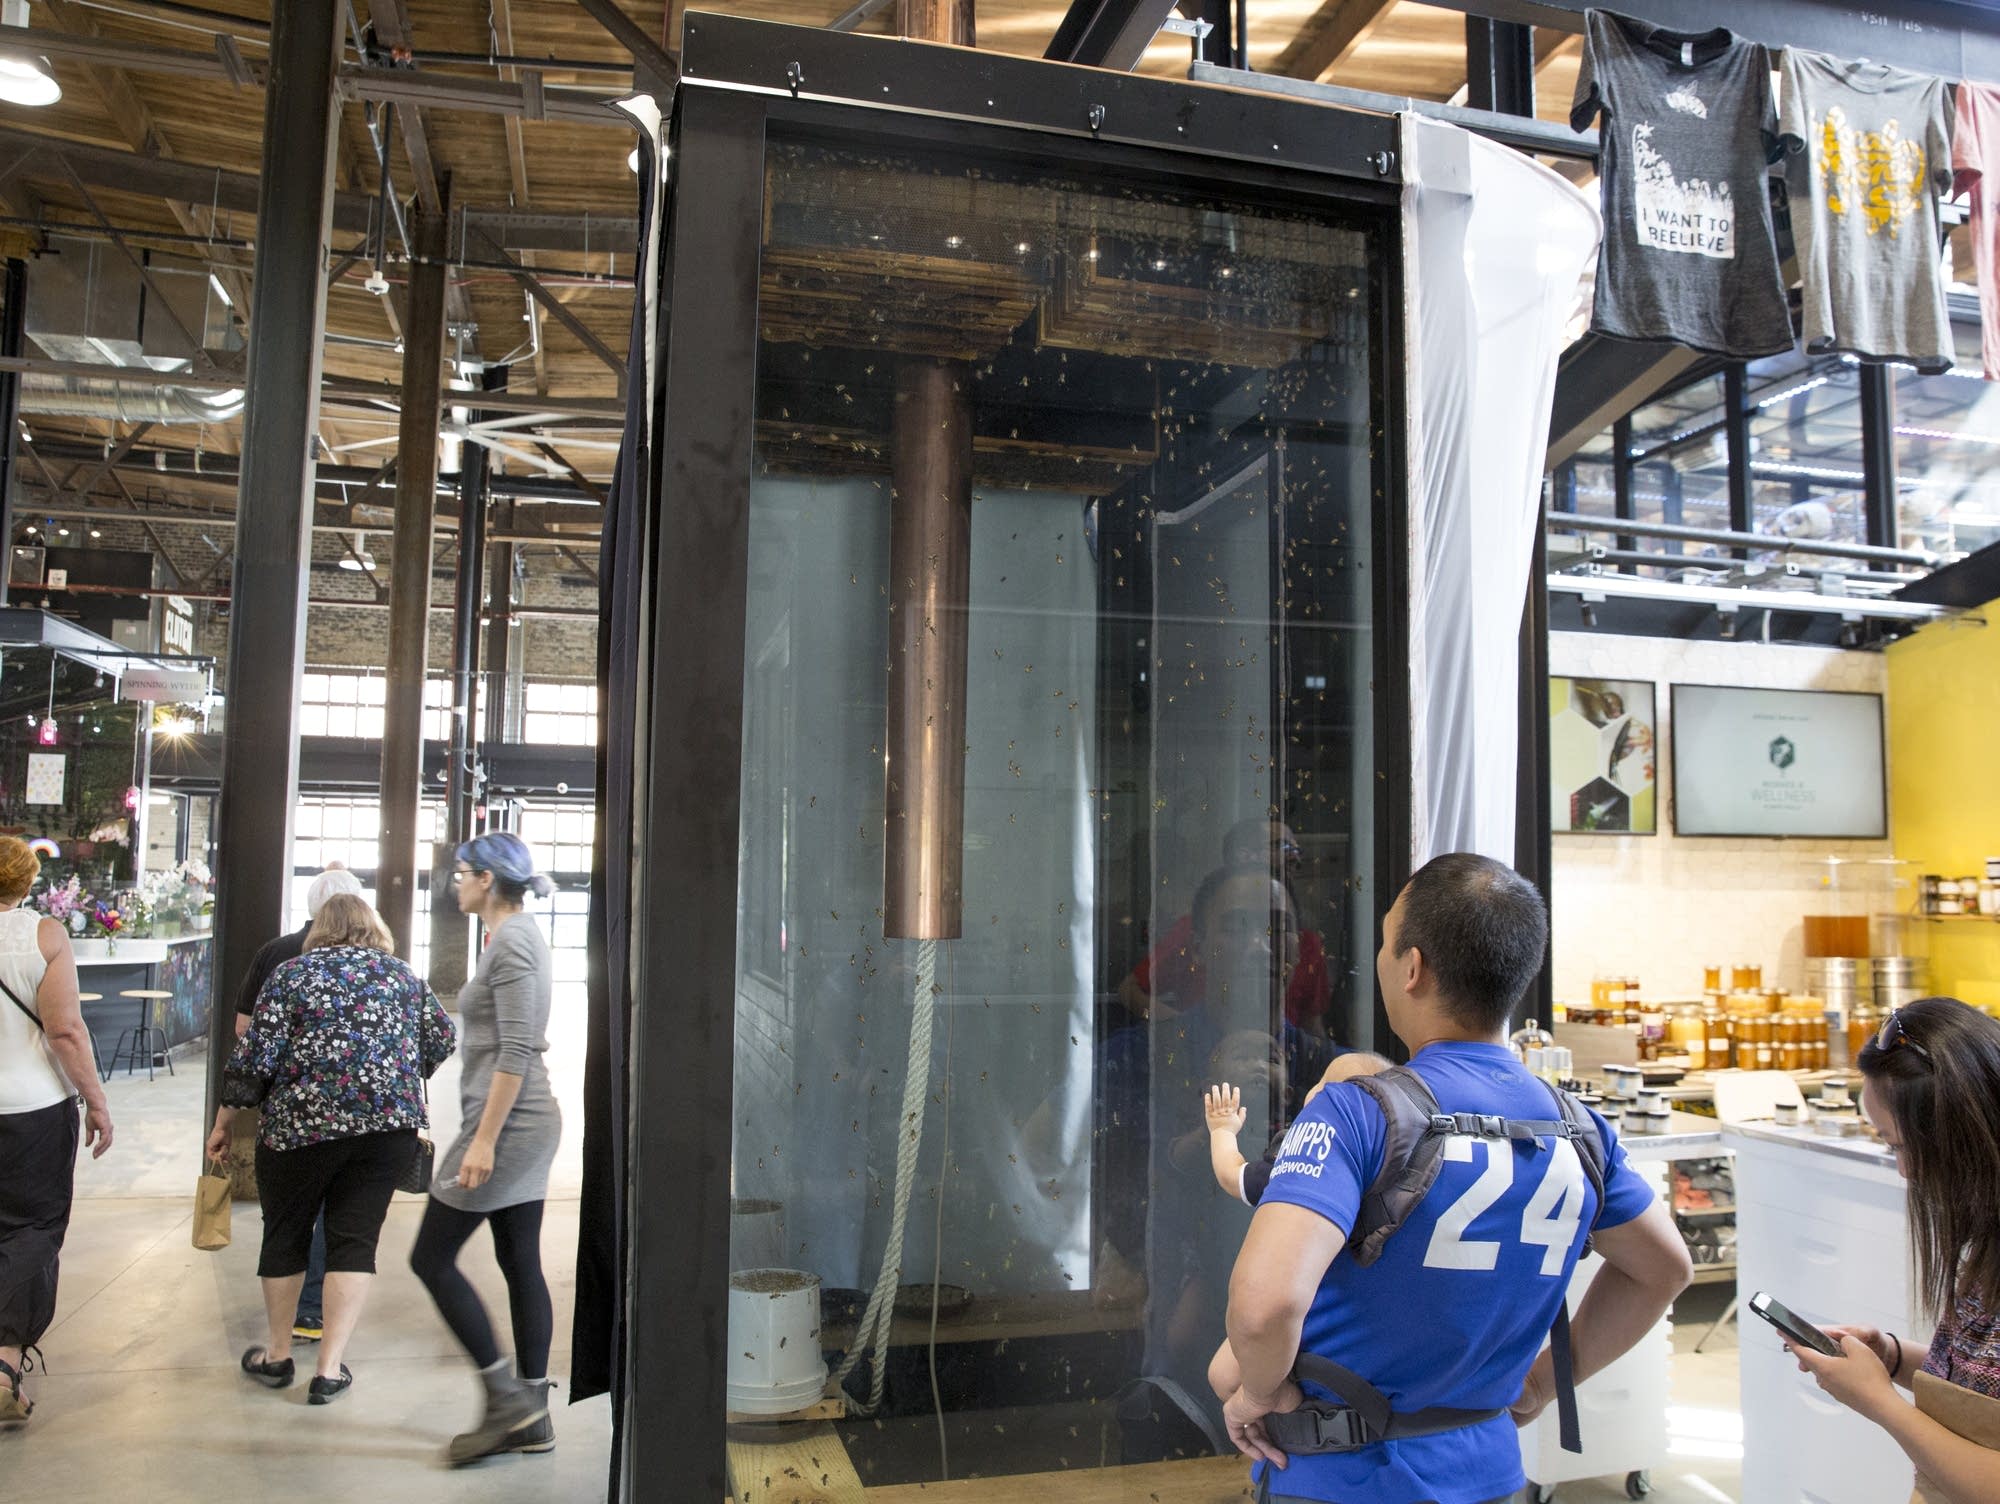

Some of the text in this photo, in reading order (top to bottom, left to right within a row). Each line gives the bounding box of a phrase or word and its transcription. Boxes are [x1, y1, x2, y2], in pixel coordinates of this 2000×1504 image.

[1642, 207, 1729, 233] I WANT TO
[127, 680, 167, 689] SPINNING
[1275, 1121, 1336, 1161] AMPPS
[1422, 1134, 1586, 1277] 24
